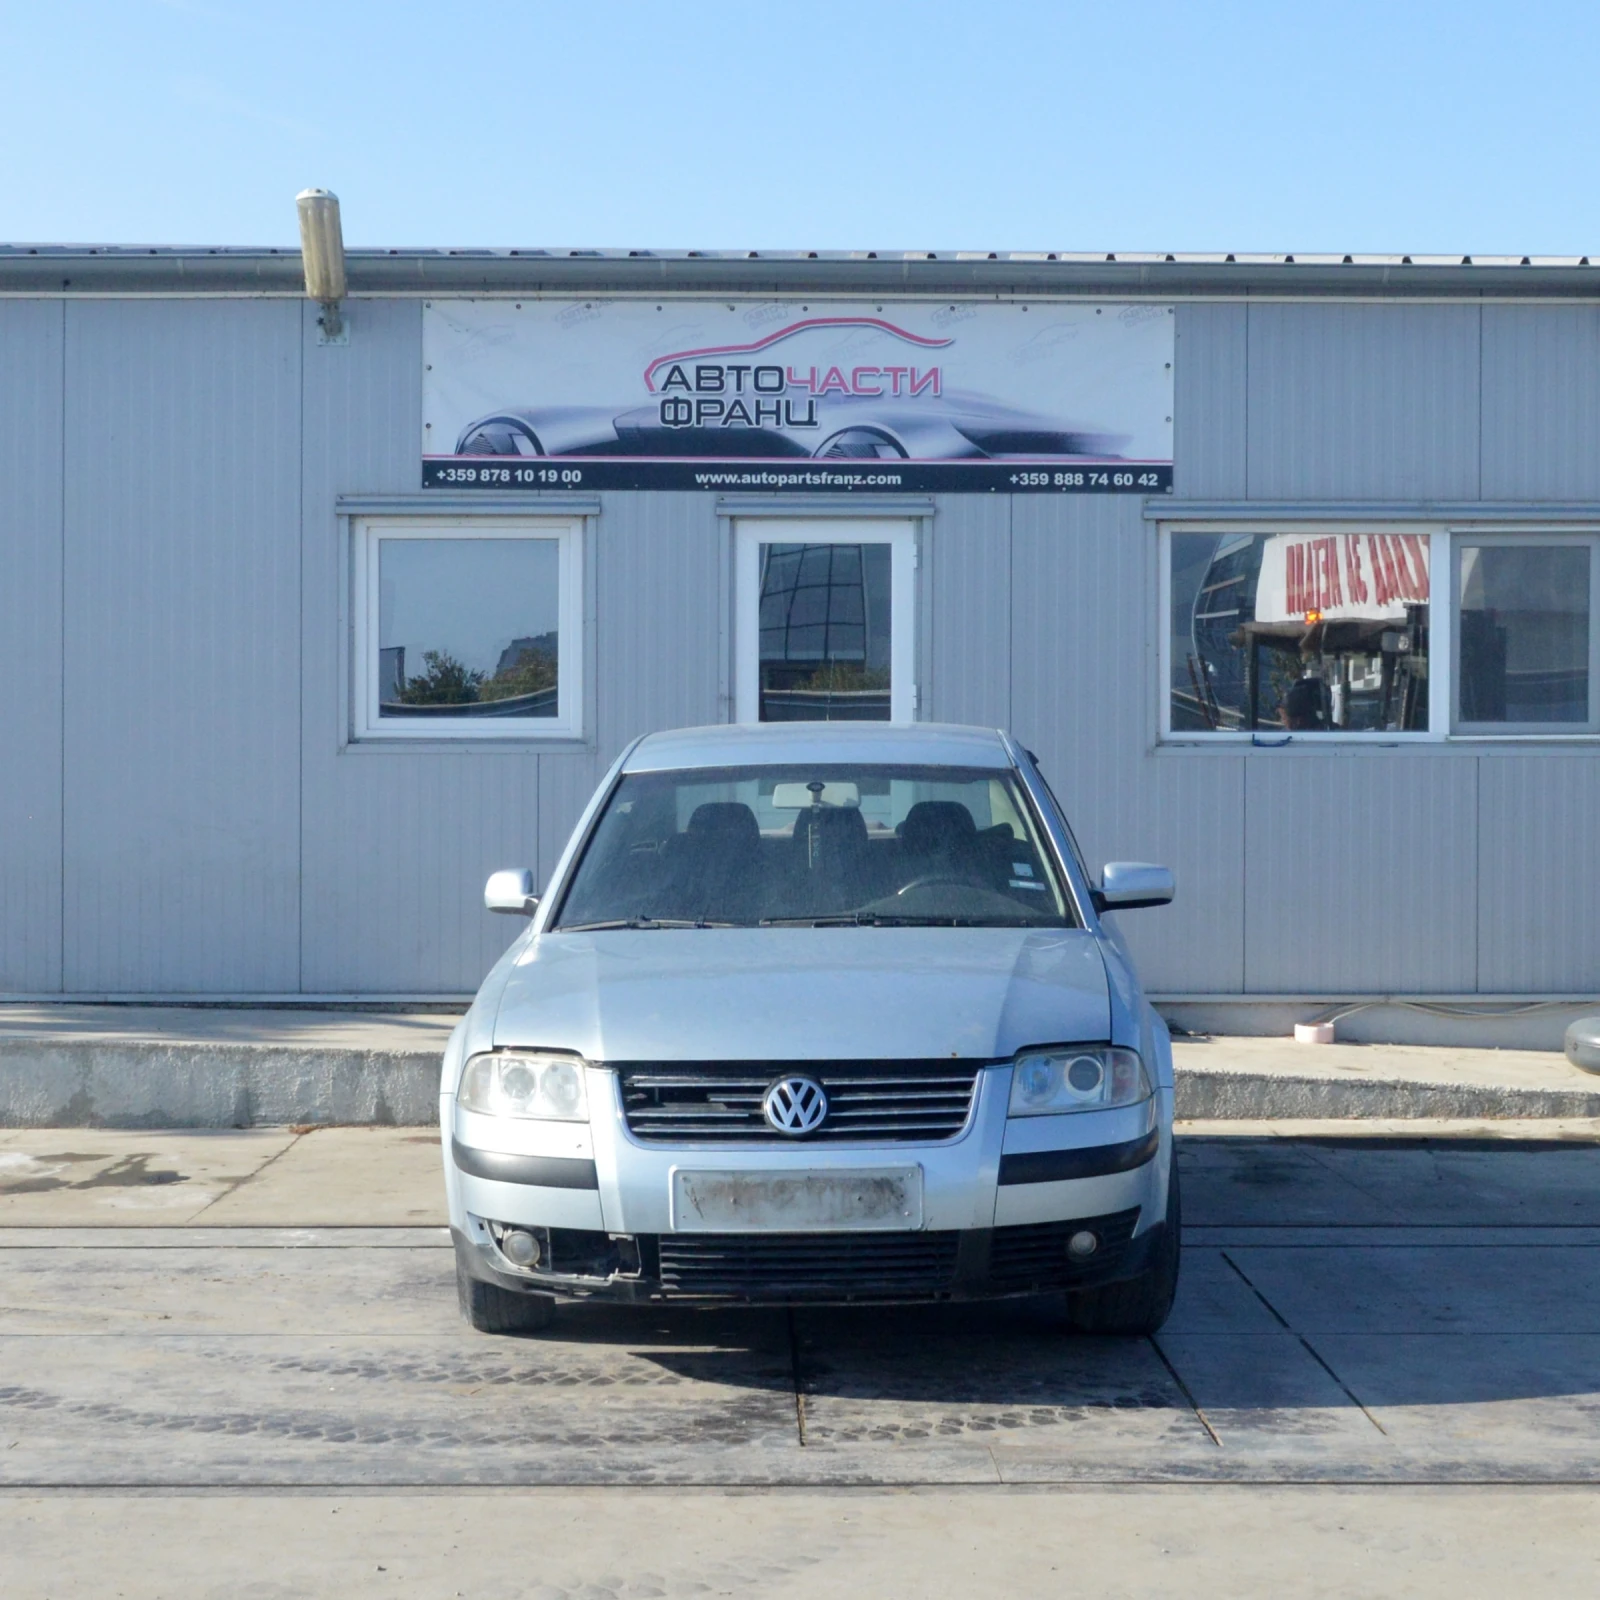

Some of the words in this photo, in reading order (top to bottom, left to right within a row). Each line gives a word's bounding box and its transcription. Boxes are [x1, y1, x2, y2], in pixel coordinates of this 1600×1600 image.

[661, 365, 939, 393] АВТОЧАСТИ
[661, 396, 818, 426] ФРАНЦ
[436, 469, 477, 482] +359
[480, 469, 510, 482] 878
[514, 469, 534, 482] 10
[538, 469, 558, 483] 19
[561, 470, 582, 483] 00
[695, 472, 902, 487] www.autopartsfranz.com
[1009, 473, 1049, 486] +359
[1054, 473, 1084, 486] 888
[1089, 473, 1109, 486] 74
[1113, 473, 1133, 486] 60
[1137, 473, 1158, 486] 42
